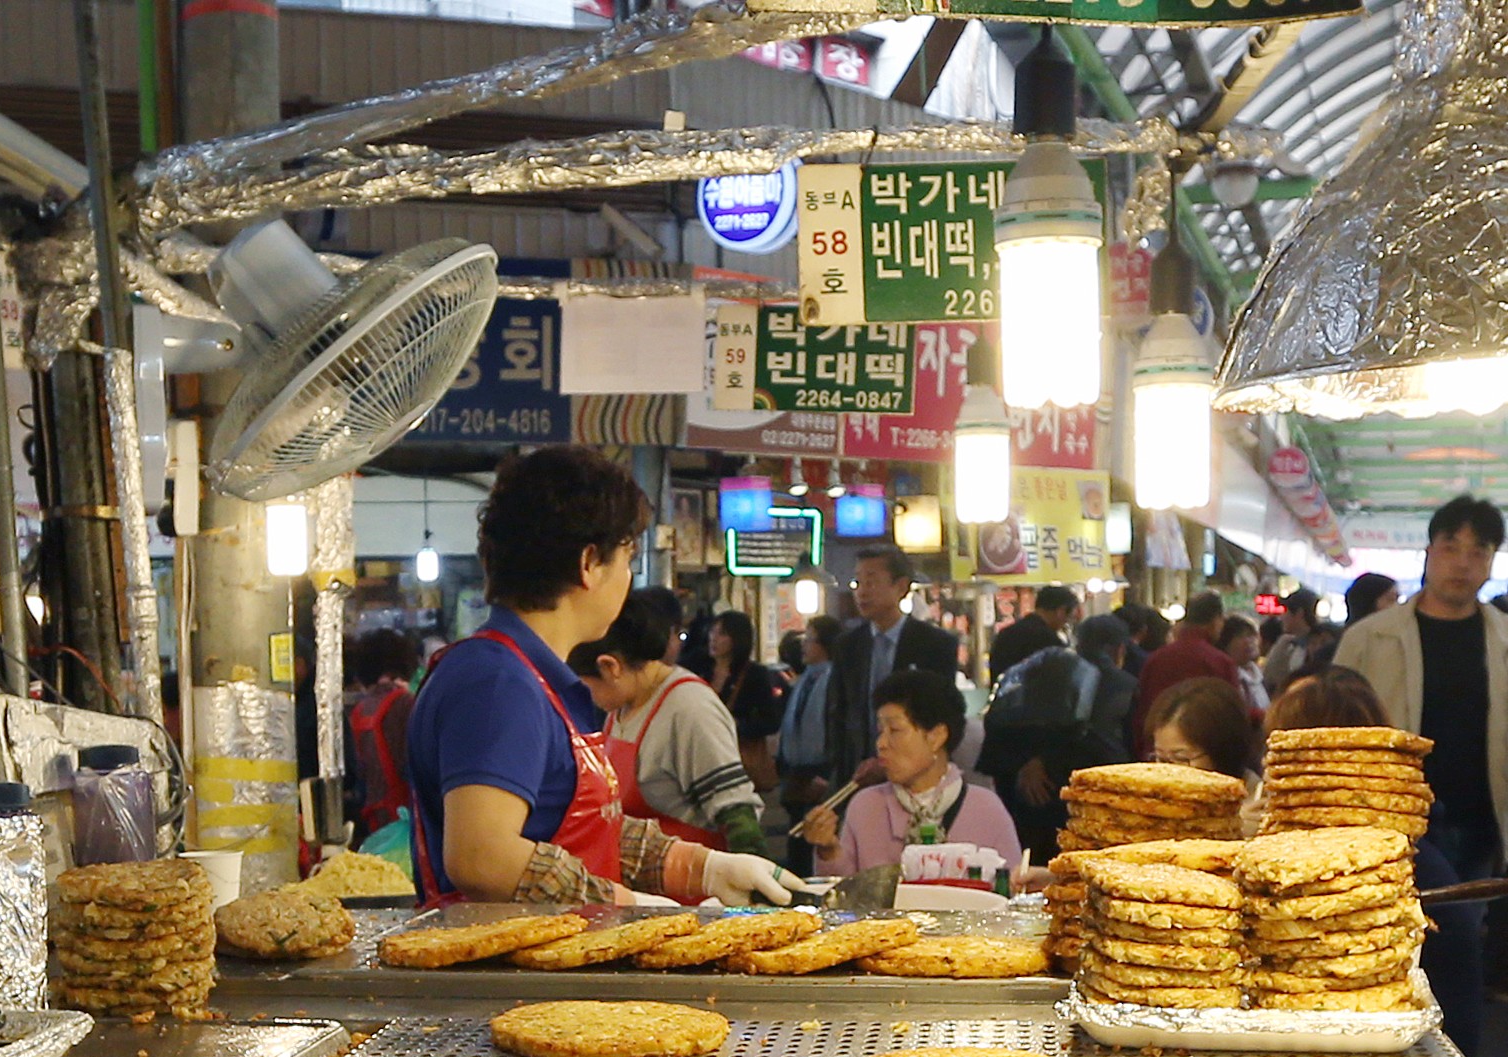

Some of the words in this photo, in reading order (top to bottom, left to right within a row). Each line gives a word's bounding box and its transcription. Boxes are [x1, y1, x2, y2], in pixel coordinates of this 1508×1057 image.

[870, 170, 1005, 214] 박가네
[811, 230, 849, 256] 58
[820, 267, 849, 295] 호
[944, 289, 1003, 316] 226
[725, 348, 747, 364] 59
[725, 371, 744, 388] 호
[766, 351, 906, 388] 빈대떡
[795, 389, 904, 409] 2264-0847
